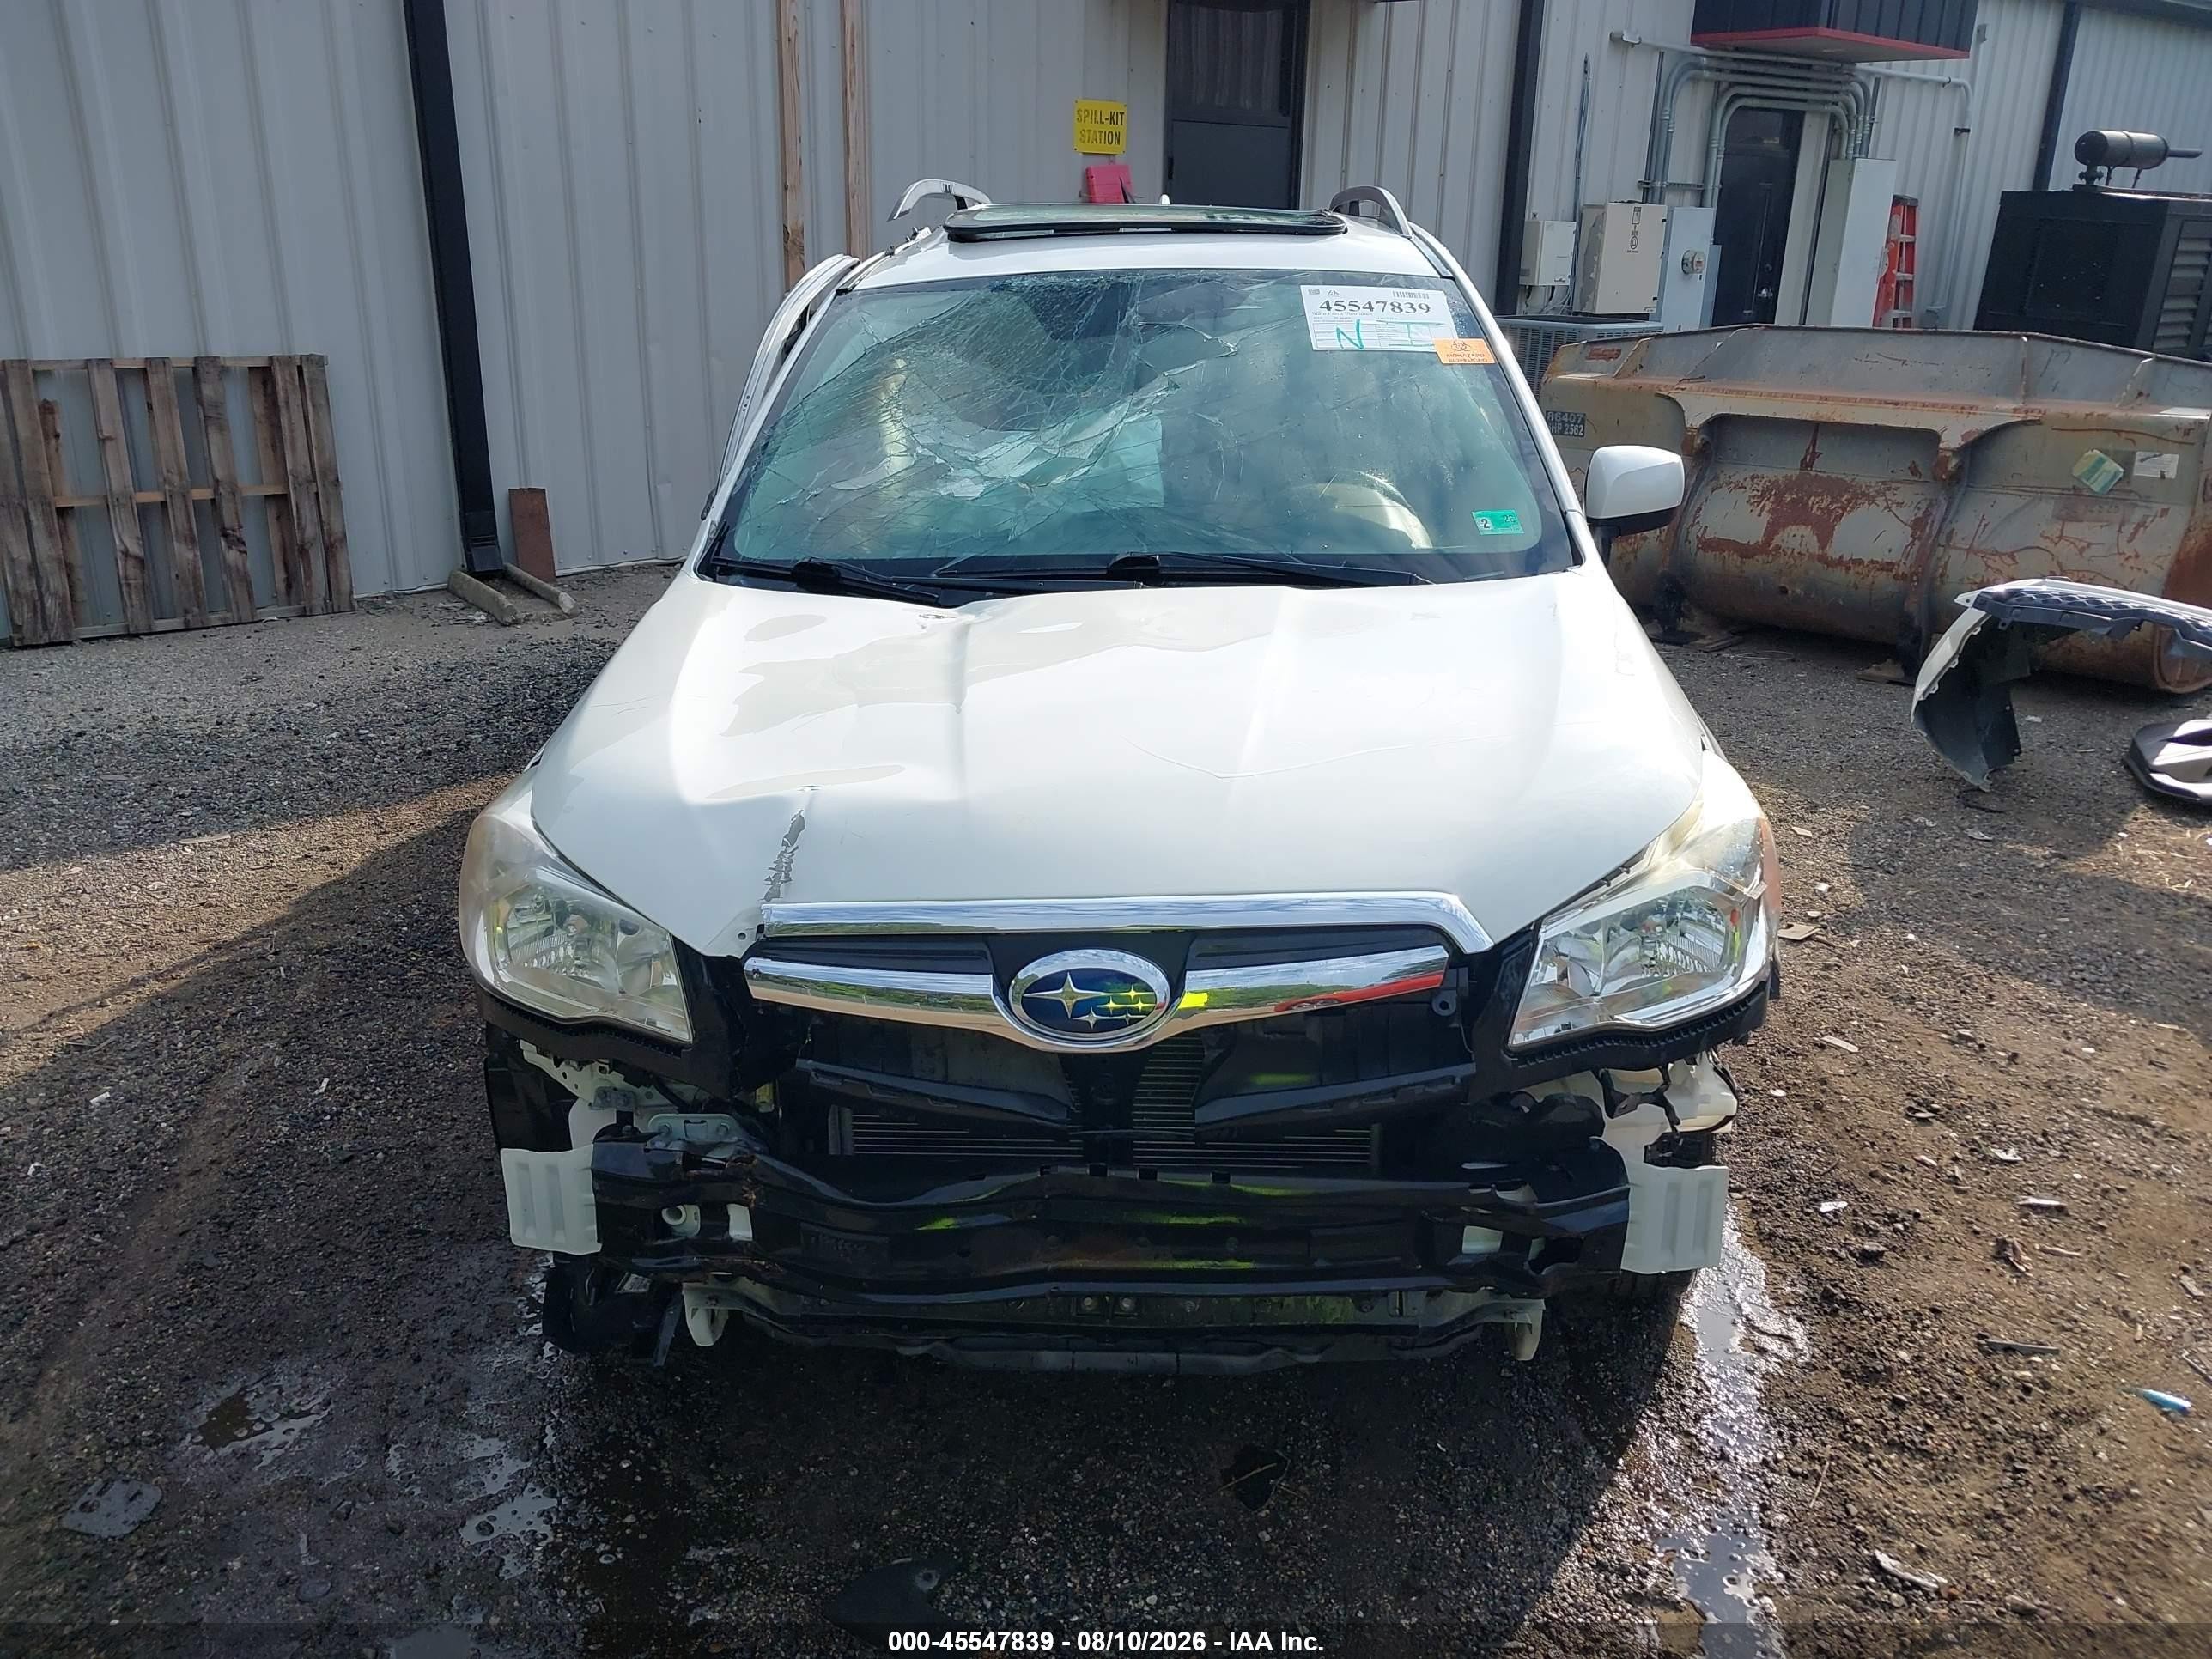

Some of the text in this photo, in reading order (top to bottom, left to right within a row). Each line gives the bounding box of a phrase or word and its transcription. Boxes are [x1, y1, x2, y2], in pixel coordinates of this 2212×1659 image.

[1077, 108, 1125, 125] SPILL-KIT
[1079, 129, 1121, 145] STATION
[1319, 300, 1431, 314] 45547839
[1335, 319, 1364, 349] N
[1547, 411, 1584, 423] 86407
[1564, 423, 1584, 436] 2562
[1480, 518, 1491, 529] 2
